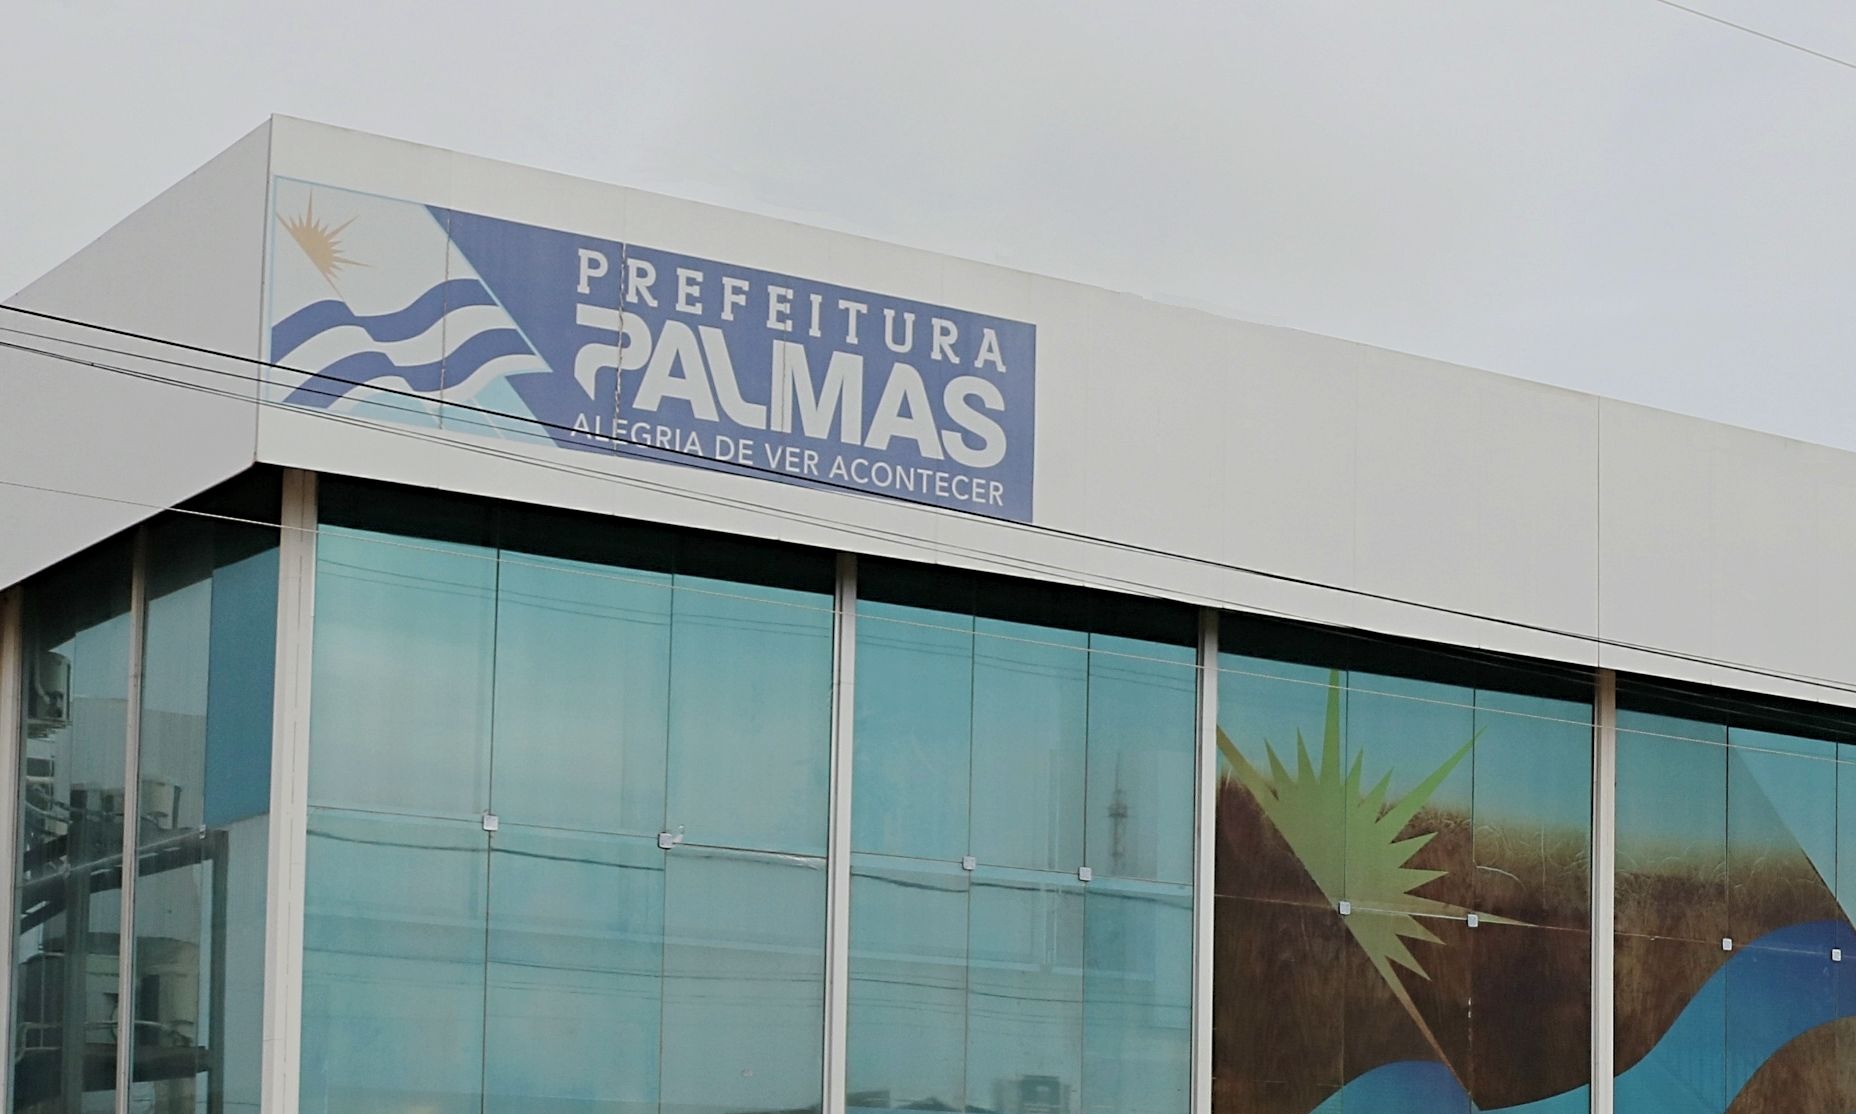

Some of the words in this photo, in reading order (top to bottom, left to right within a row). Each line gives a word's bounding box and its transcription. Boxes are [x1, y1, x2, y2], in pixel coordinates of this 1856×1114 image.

[577, 248, 1007, 373] PREFEITURA
[574, 303, 1007, 469] PALMAS
[570, 413, 702, 458] ALEGRIA
[715, 435, 753, 466] DE
[765, 443, 819, 476] VER
[829, 455, 1004, 506] ACONTECER
